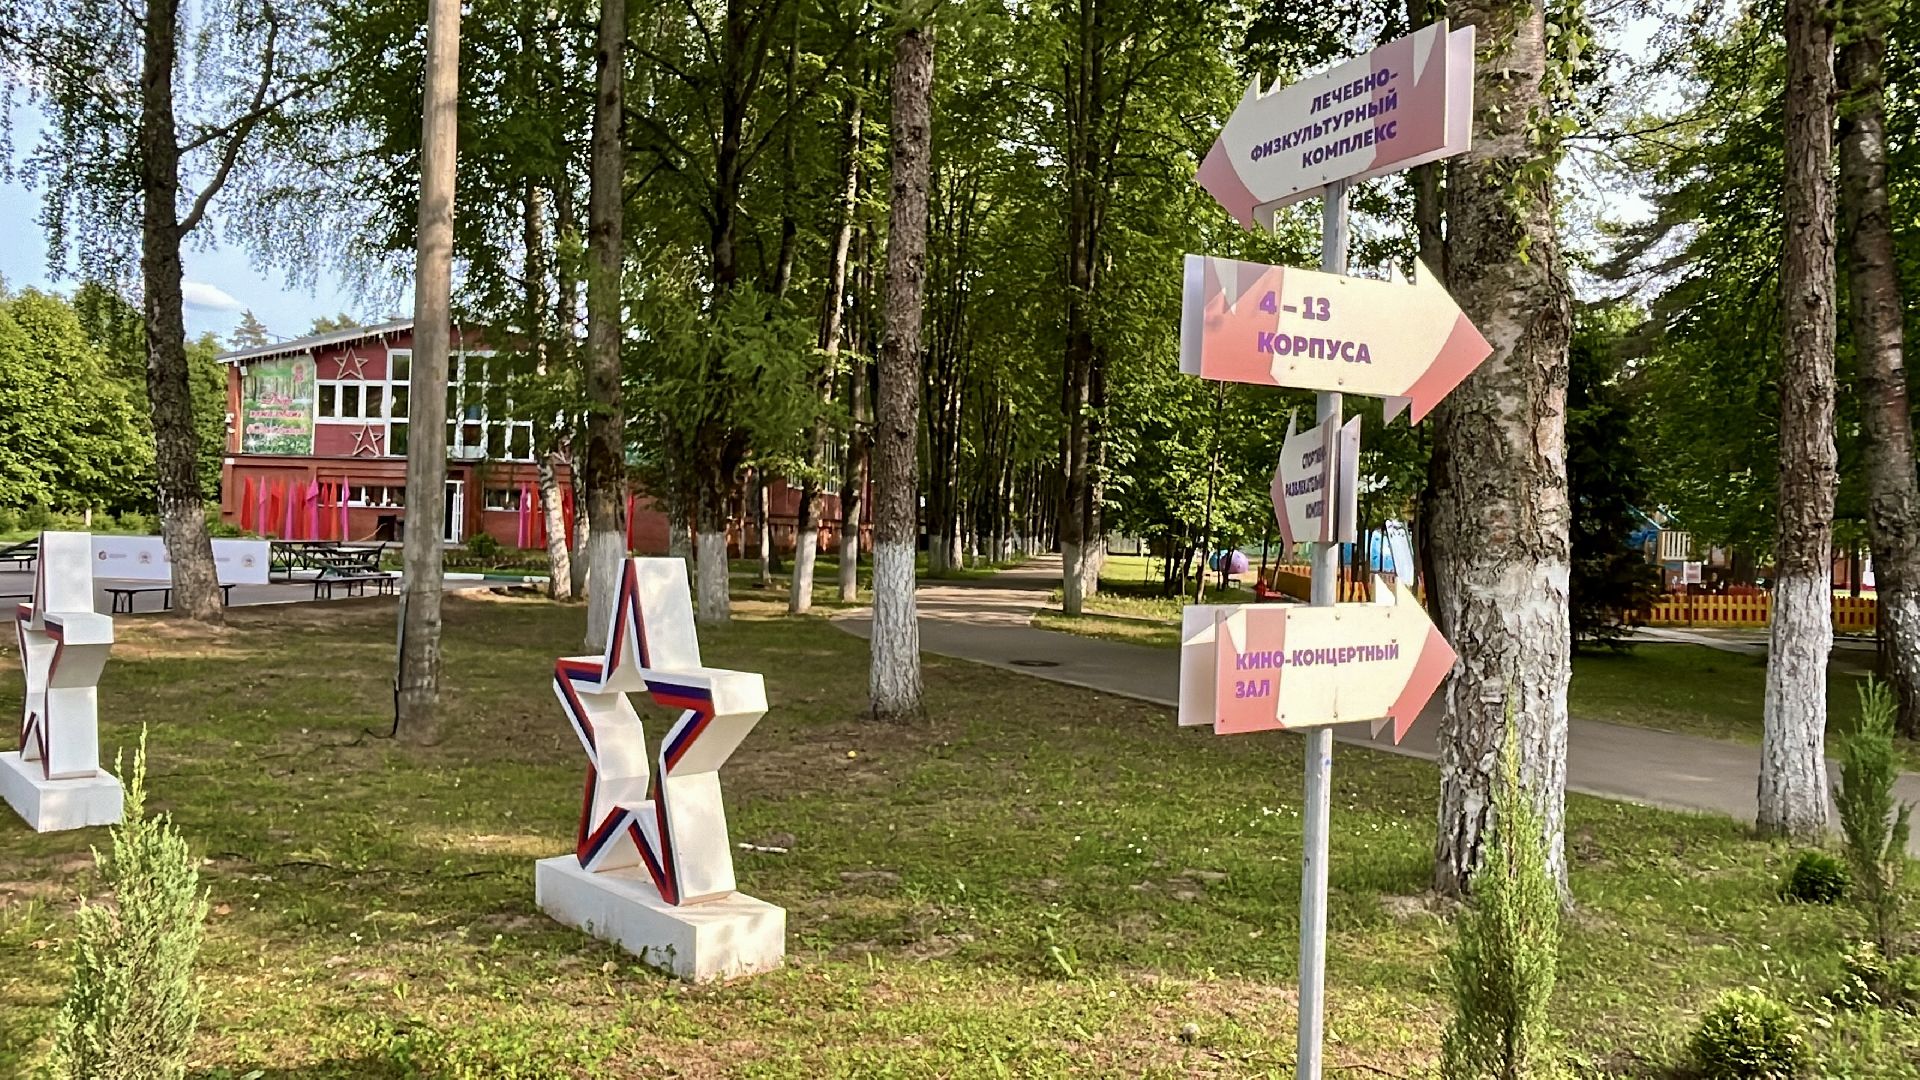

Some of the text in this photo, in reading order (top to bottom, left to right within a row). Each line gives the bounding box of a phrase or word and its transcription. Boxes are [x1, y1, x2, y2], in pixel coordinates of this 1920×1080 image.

[1310, 67, 1399, 115] ЛЕЧЕБНО-
[1250, 88, 1398, 163] ФИЗКУЛЬТУРНЫЙ
[1302, 120, 1398, 169] КОМПЛЕКС
[1259, 290, 1278, 316] 4
[1302, 296, 1331, 322] 13
[1257, 331, 1372, 365] КОРПУСА
[1235, 638, 1400, 671] КИНО-КОНЦЕРТНЫЙ
[1235, 679, 1271, 699] ЗАЛ
